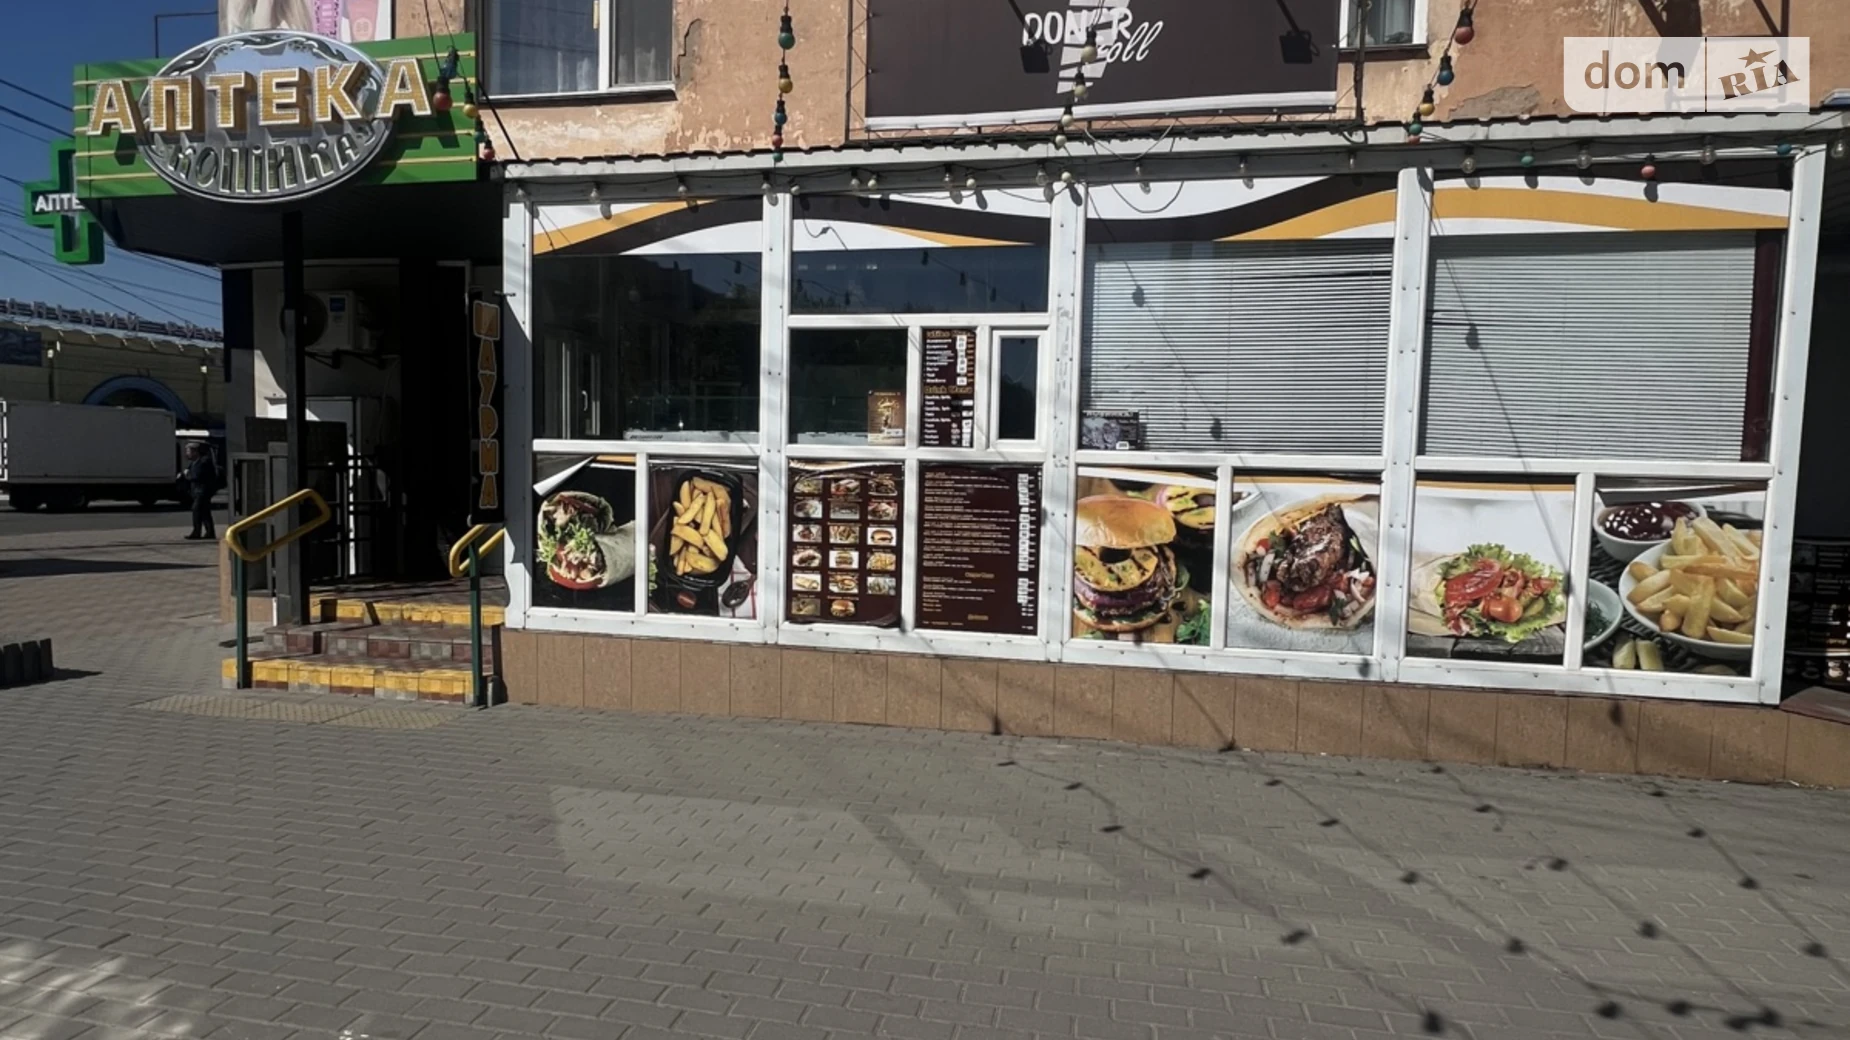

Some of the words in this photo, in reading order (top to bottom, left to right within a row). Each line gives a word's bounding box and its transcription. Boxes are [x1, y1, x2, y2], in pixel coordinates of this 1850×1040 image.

[1092, 21, 1164, 63] oll
[86, 58, 433, 136] АПТЕКА
[167, 135, 360, 194] КОПІЙКА
